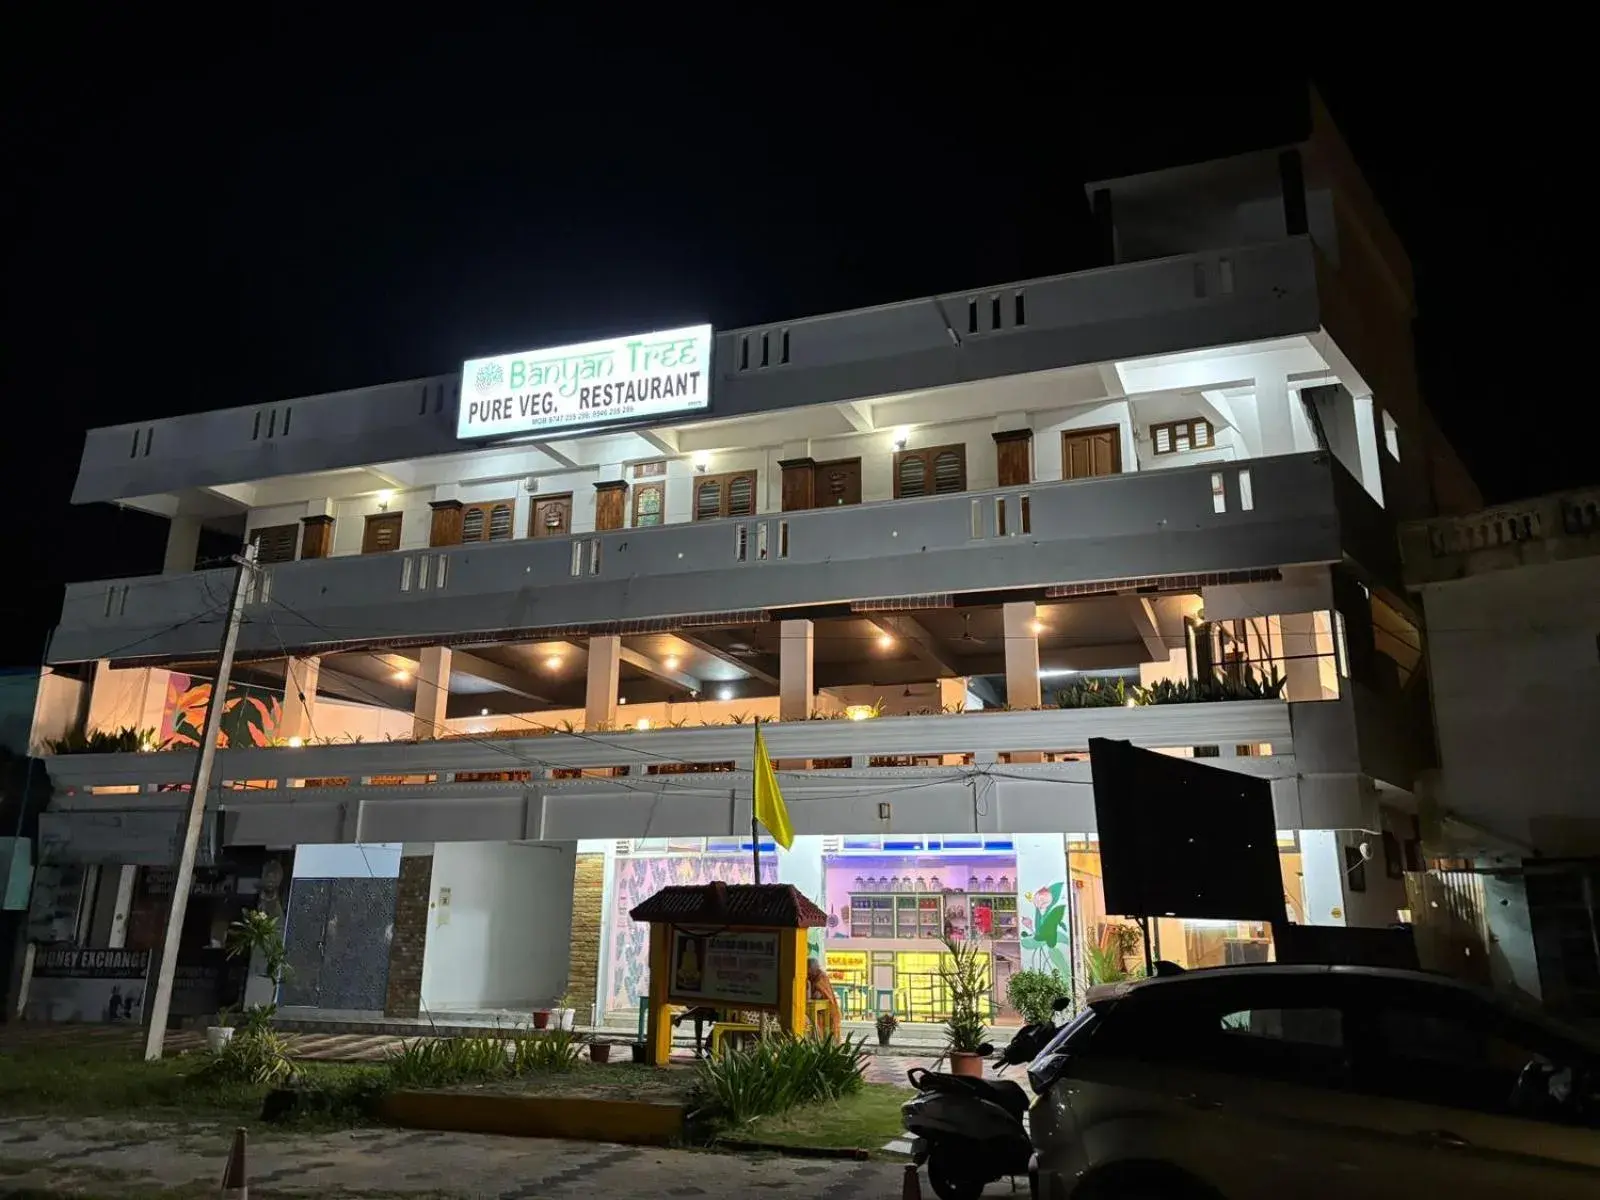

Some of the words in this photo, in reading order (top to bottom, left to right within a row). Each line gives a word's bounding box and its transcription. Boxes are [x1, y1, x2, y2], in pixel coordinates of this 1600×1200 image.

[510, 350, 615, 397] Banyan
[626, 337, 697, 372] Tree
[468, 397, 513, 424] PURE
[519, 391, 558, 416] VEG.
[579, 371, 700, 409] RESTAURANT
[36, 951, 78, 969] MONEY
[81, 950, 148, 969] EXCHANGE
